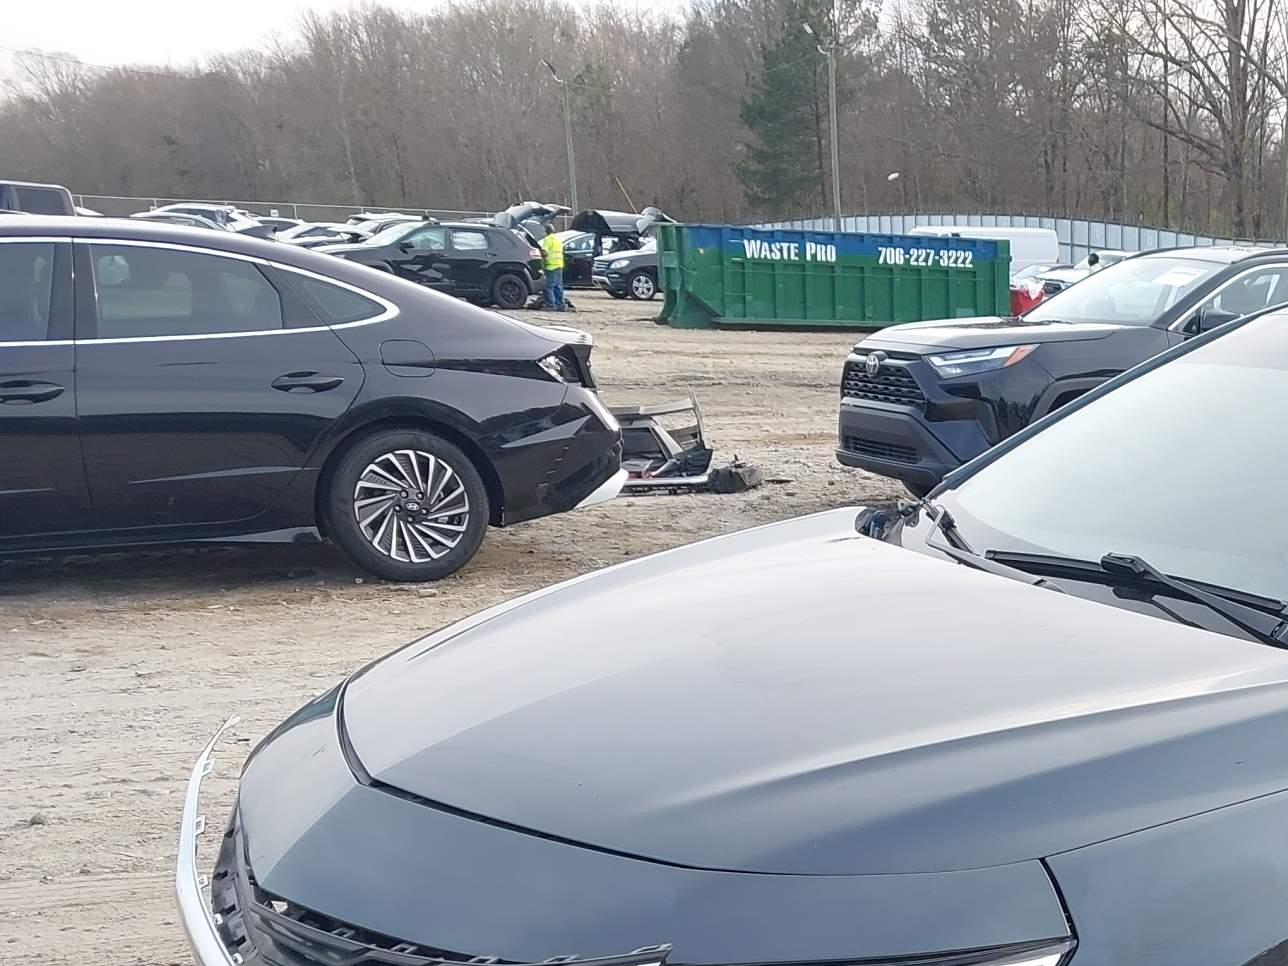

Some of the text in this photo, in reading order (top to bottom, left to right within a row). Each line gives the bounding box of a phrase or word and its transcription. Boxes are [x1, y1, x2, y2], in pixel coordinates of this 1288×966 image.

[743, 238, 837, 263] WASTE PRO
[877, 245, 974, 269] 706-227-3222
